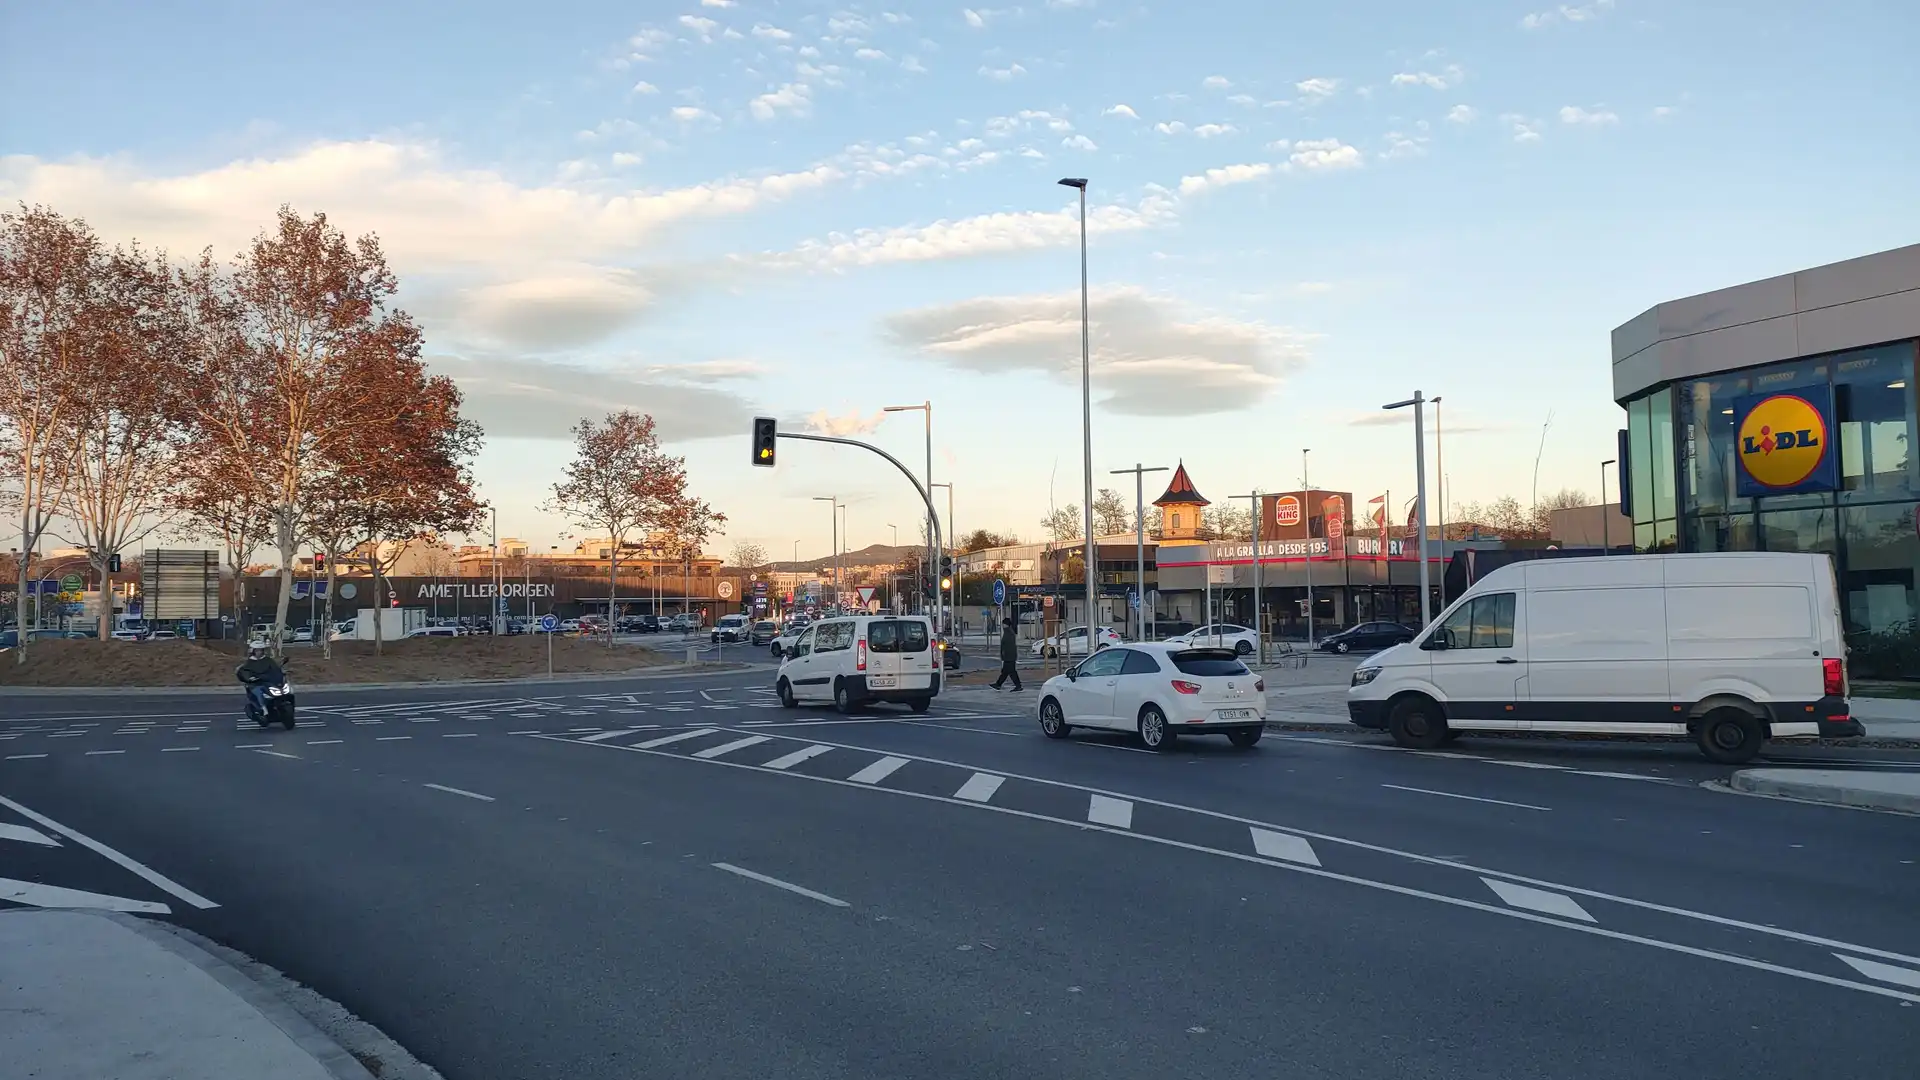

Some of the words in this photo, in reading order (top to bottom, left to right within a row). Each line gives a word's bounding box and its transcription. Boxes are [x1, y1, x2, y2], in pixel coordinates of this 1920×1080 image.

[1277, 504, 1298, 512] BURGER
[1277, 511, 1298, 519] KING
[1237, 545, 1274, 557] GRALLA
[1278, 543, 1307, 555] DESDE
[1309, 541, 1329, 553] 195
[417, 584, 498, 598] AMETLLER
[501, 583, 555, 597] ORIGEN
